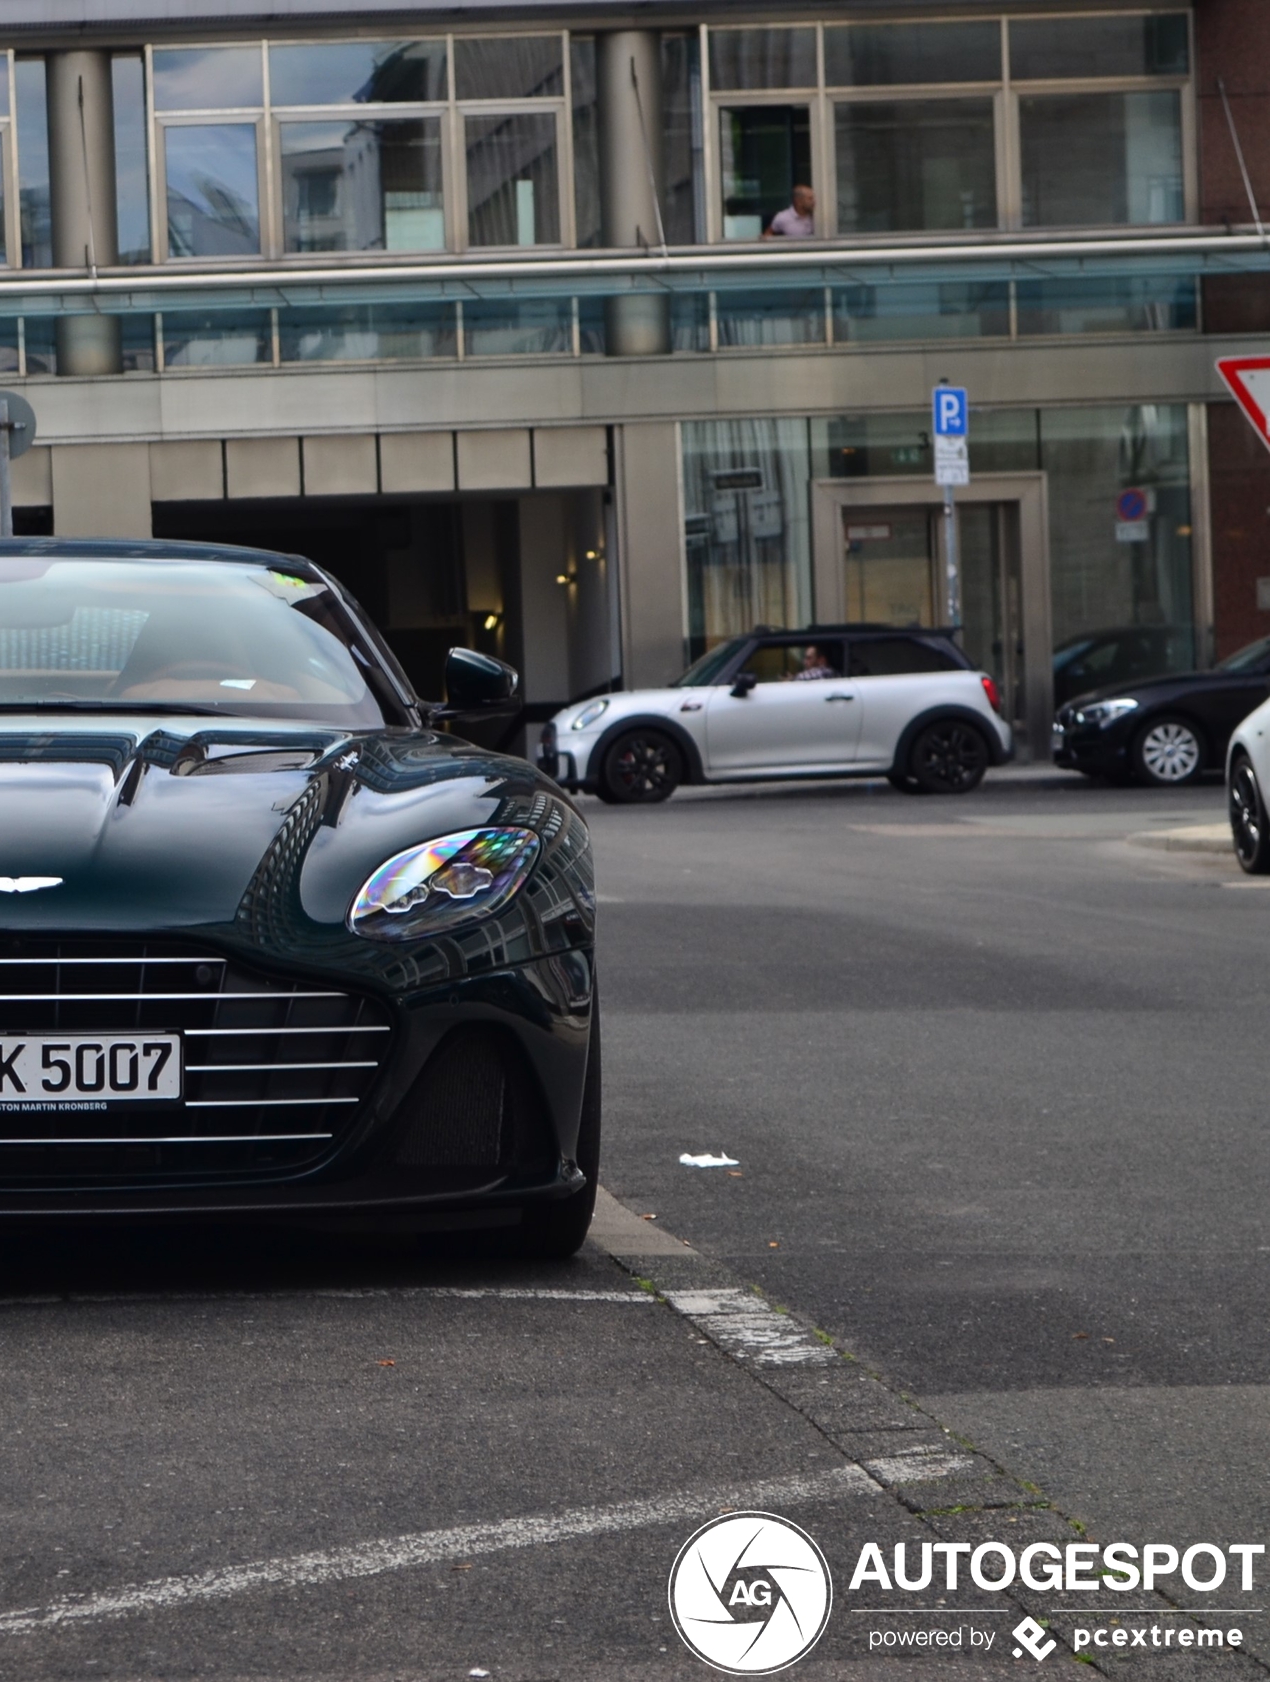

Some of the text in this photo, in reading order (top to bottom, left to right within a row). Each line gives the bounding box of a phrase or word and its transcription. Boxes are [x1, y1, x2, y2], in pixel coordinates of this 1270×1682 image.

[940, 393, 960, 432] P
[41, 1042, 172, 1093] 5007
[21, 1103, 57, 1112] MARTIN
[58, 1102, 108, 1111] KRONBERG
